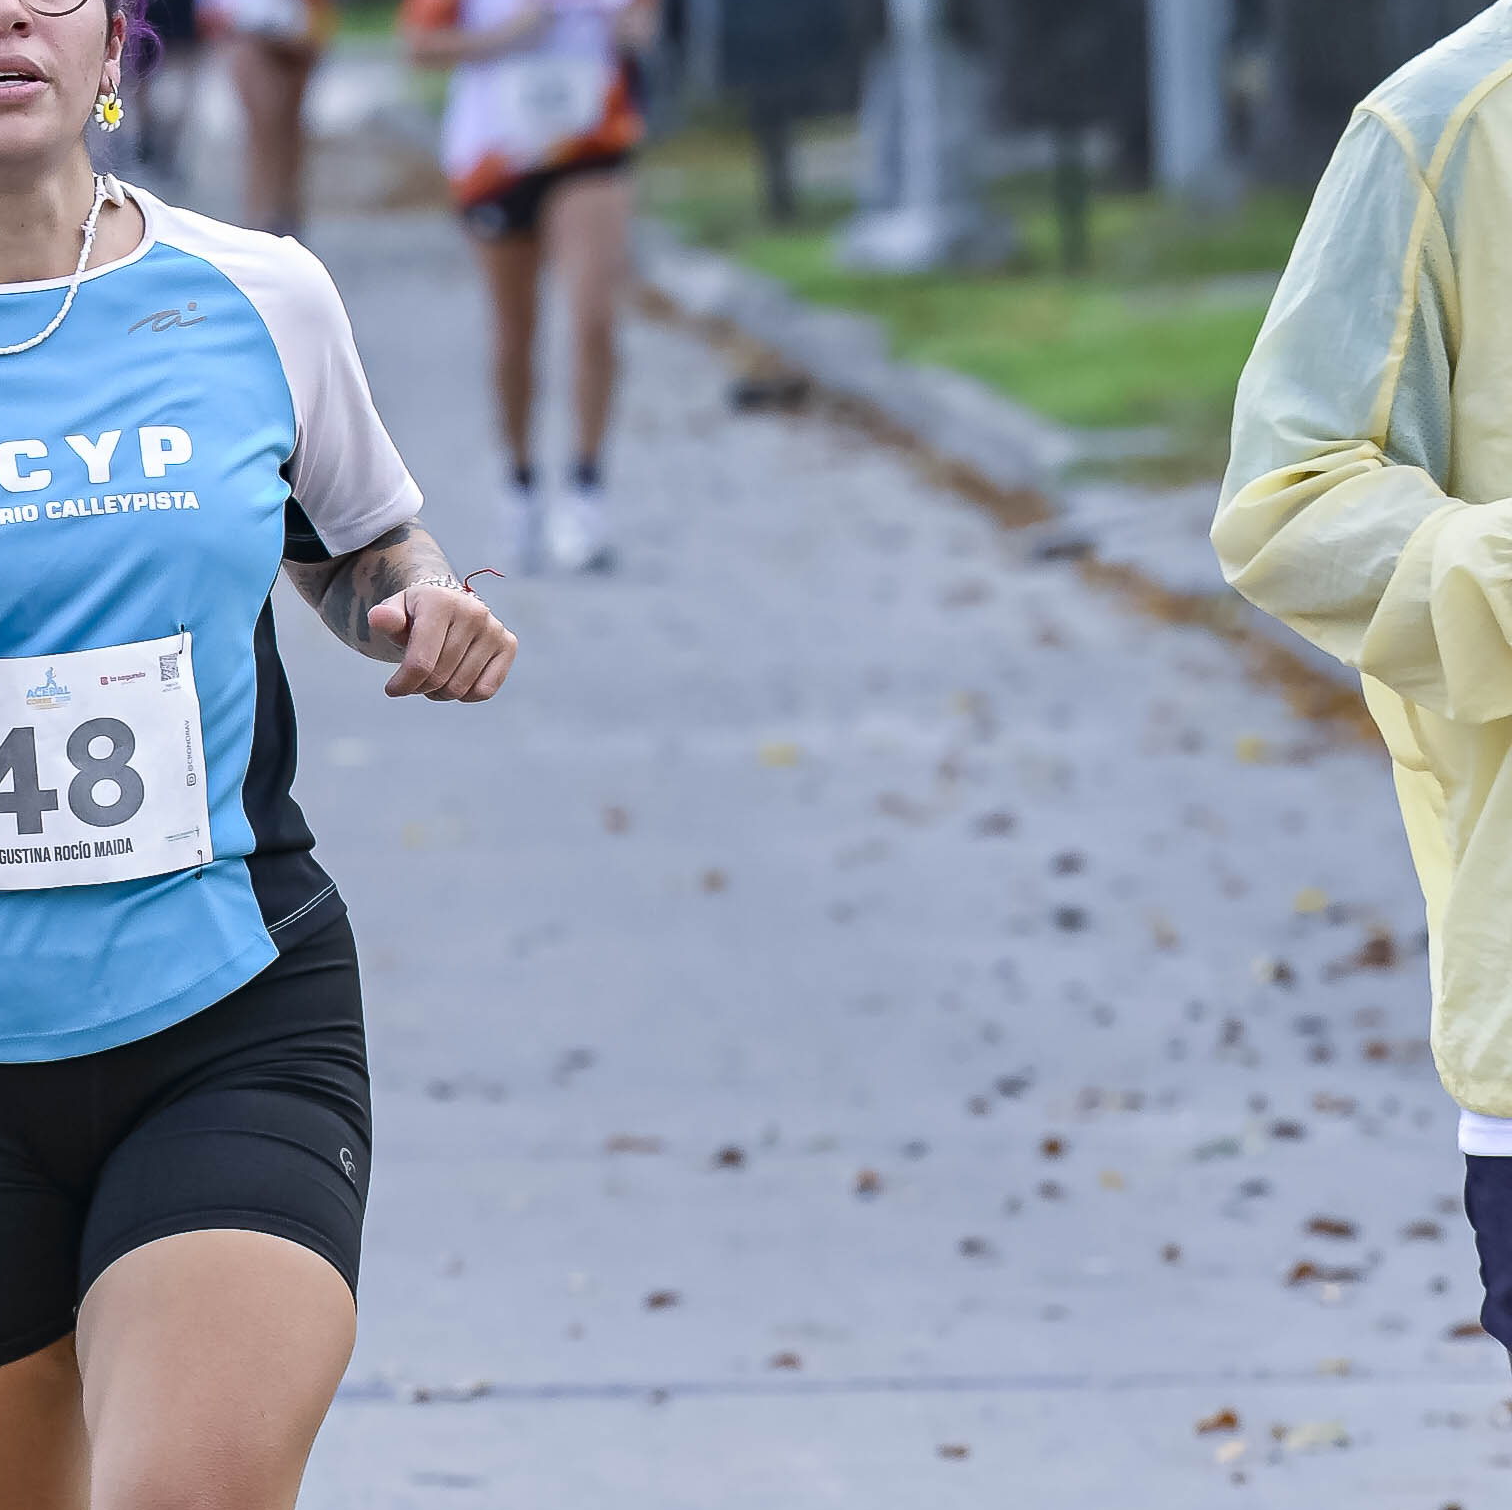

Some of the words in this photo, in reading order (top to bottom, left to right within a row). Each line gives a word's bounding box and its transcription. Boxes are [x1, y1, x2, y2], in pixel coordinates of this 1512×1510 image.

[46, 491, 200, 520] CALLEYPISTA
[54, 841, 91, 862] ROCÍO
[94, 837, 134, 858] MAIDA
